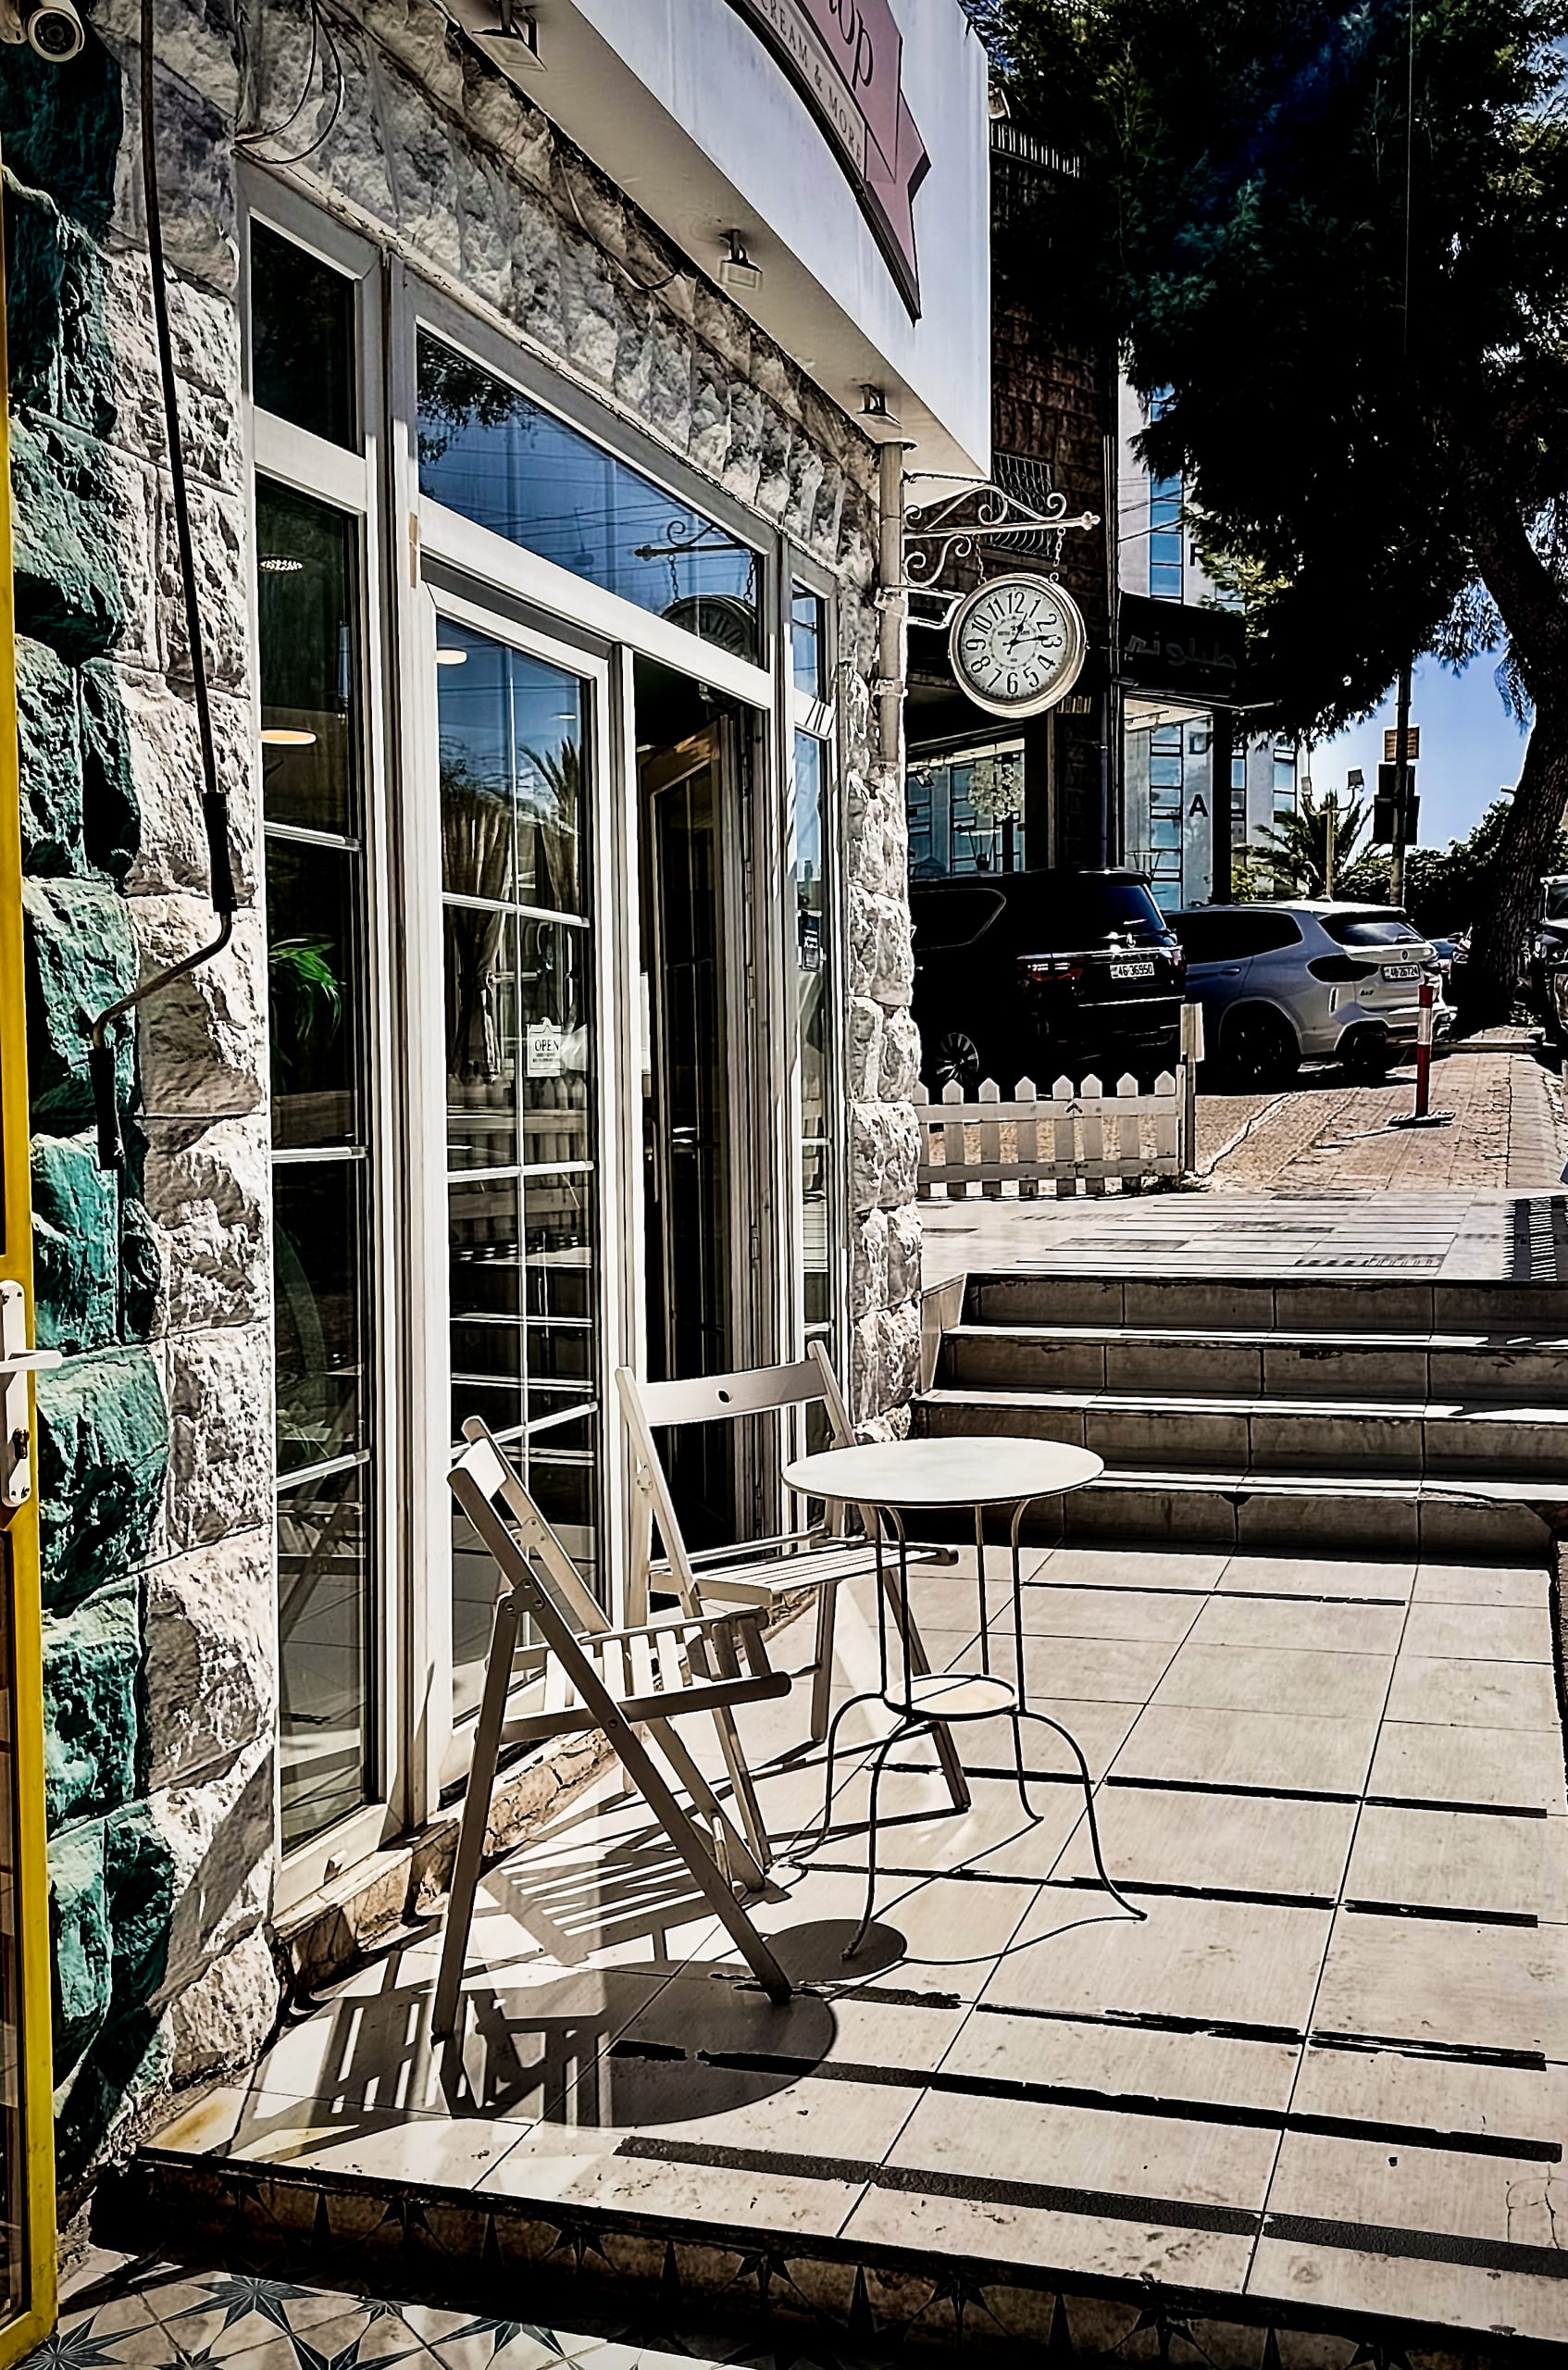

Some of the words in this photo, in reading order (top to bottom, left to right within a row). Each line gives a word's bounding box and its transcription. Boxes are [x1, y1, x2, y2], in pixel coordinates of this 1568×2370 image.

[828, 0, 873, 90] op
[815, 65, 822, 92] &
[828, 85, 862, 168] MORE
[987, 598, 1005, 620] 11
[1007, 592, 1025, 614] 12
[1029, 599, 1041, 617] 1
[972, 614, 992, 635] 10
[1036, 614, 1057, 631] 2
[965, 639, 986, 651] 9
[971, 655, 990, 673] 8
[1038, 655, 1056, 670] 4
[988, 667, 1002, 688] 7
[1006, 672, 1018, 694] 6
[1023, 667, 1039, 688] 5
[1188, 793, 1208, 817] A
[534, 1039, 559, 1052] OPEN
